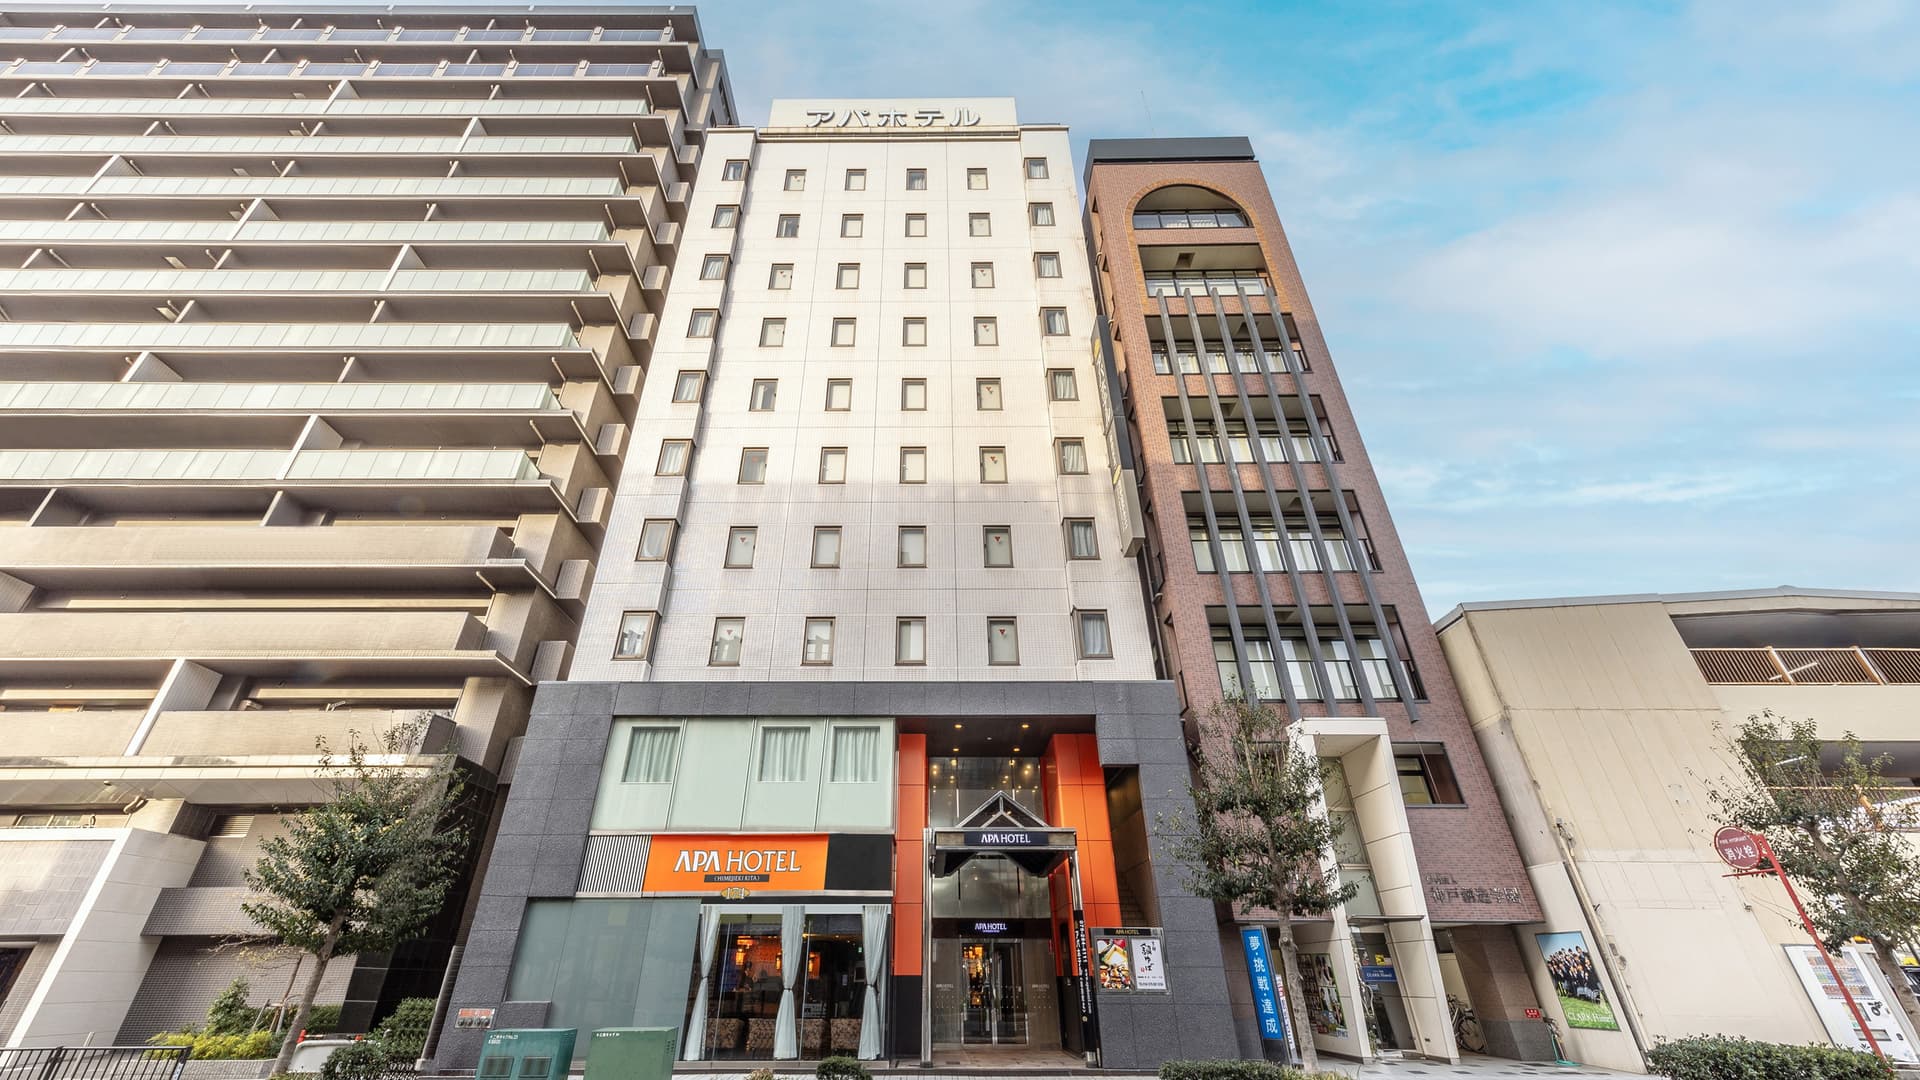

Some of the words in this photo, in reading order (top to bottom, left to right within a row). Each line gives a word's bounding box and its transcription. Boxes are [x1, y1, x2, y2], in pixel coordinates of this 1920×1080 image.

[806, 107, 981, 127] アパホテル
[981, 833, 1000, 843] APA
[1000, 833, 1031, 843] HOTEL
[673, 850, 721, 872] APA
[725, 850, 801, 872] HOTEL
[1725, 844, 1756, 861] 消火栓
[974, 922, 987, 930] APA
[987, 922, 1008, 930] HOTEL
